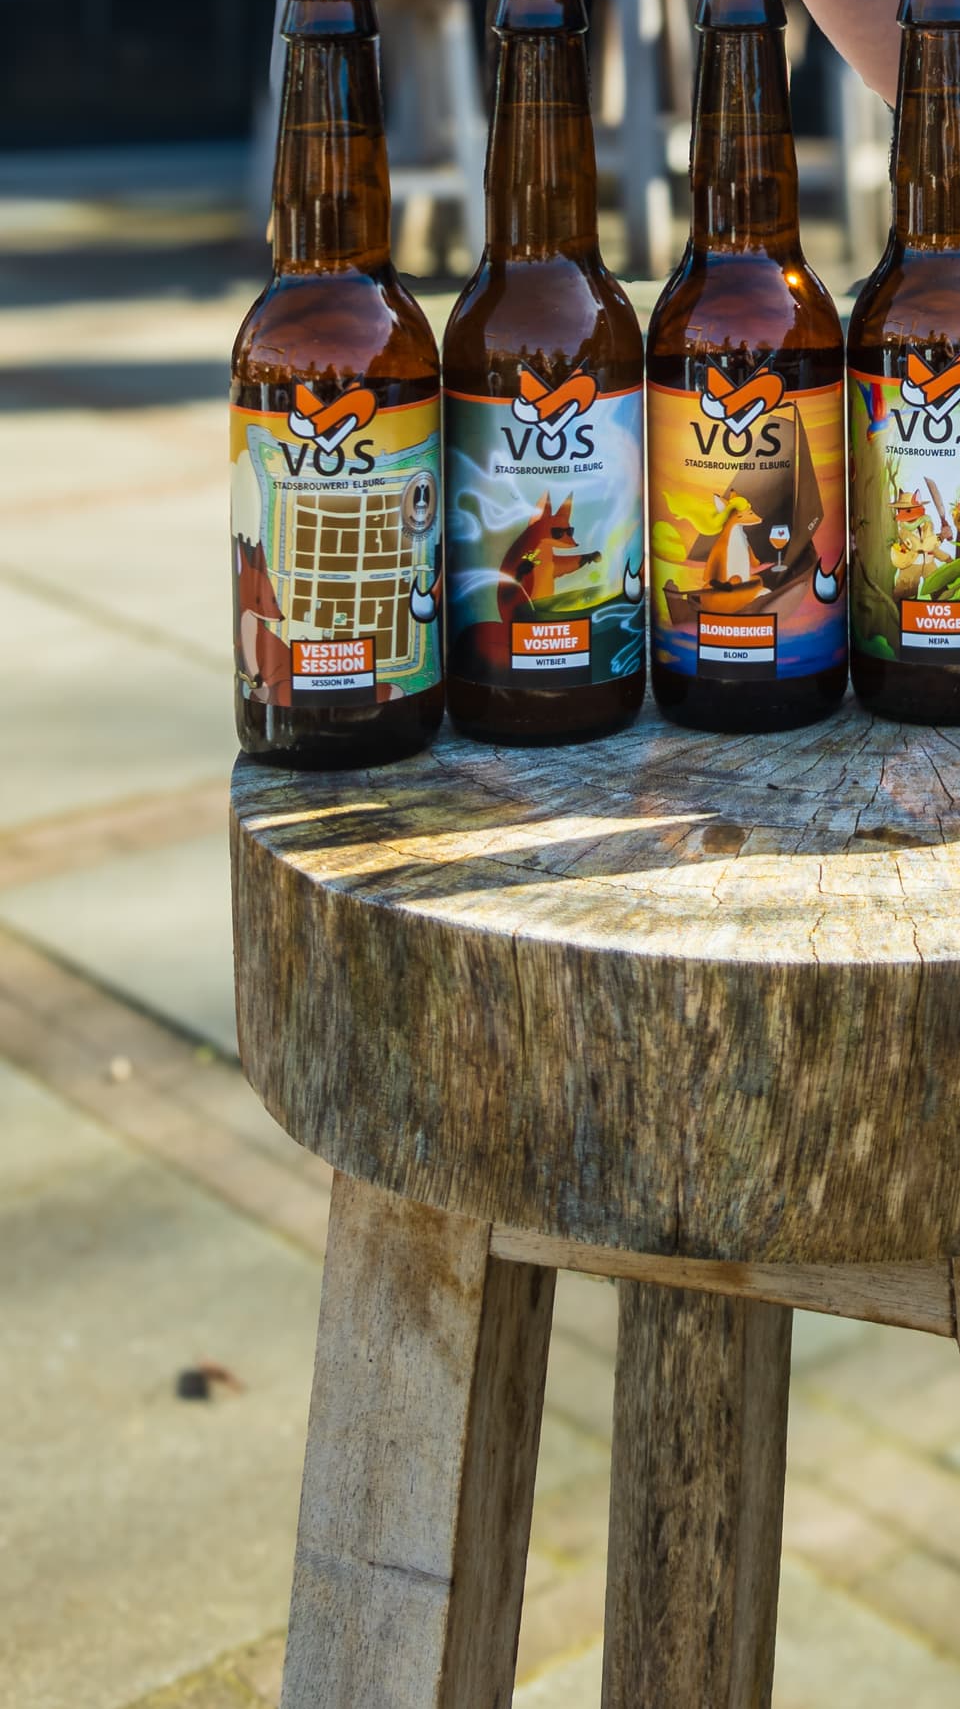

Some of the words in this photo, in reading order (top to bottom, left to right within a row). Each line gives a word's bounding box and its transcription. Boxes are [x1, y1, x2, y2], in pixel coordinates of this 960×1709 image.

[501, 425, 595, 461] VOS
[690, 422, 782, 457] VOS
[886, 445, 956, 457] STADSBROUWERIJ
[278, 440, 375, 477] VOS
[684, 459, 755, 470] STADSBROUWERIJ
[760, 461, 790, 470] ELBURG
[495, 465, 569, 474] STADSBROUWERIJ
[574, 462, 603, 473] ELBURG
[273, 481, 348, 490] STADSBROUWERIJ
[353, 478, 385, 488] ELBURG
[926, 605, 951, 616] VOS
[532, 624, 570, 637] WITTE
[700, 623, 773, 637] BLONDBEKKER
[524, 637, 579, 650] VOSWIEF
[928, 637, 949, 645] NEIPA
[301, 641, 365, 658] VESTING
[723, 651, 748, 659] BLOND
[301, 657, 365, 673] SESSION
[536, 658, 566, 666] WITBIER
[311, 679, 342, 687] SESSION
[343, 678, 355, 686] IPA
